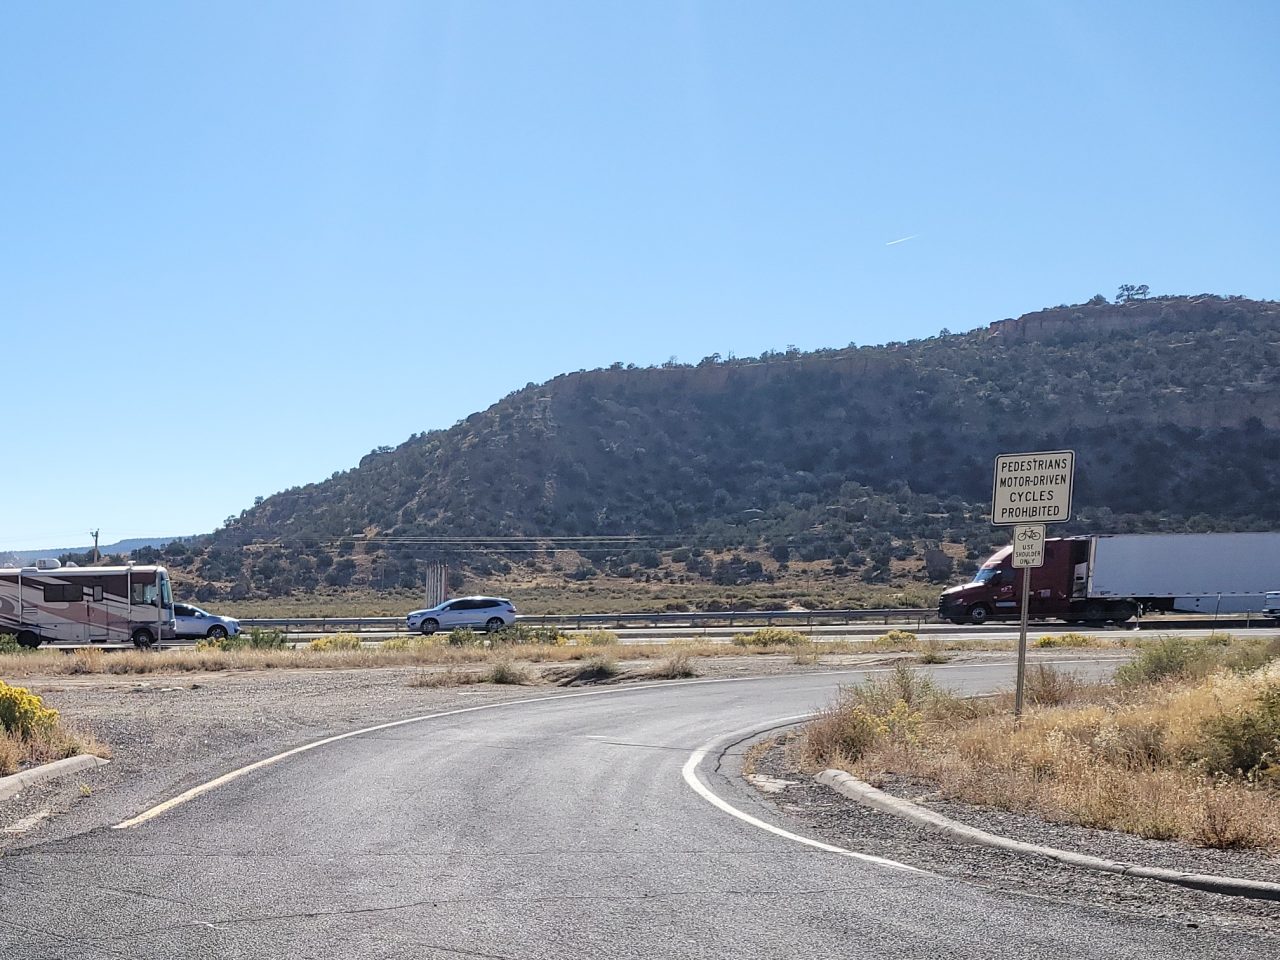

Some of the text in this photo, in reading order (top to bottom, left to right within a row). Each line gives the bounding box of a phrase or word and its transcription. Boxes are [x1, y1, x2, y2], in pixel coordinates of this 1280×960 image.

[1001, 459, 1067, 472] PEDESTRIANS
[1000, 474, 1067, 487] MOTOR-DRIVEN
[1009, 491, 1054, 502] CYCLES
[1001, 506, 1059, 518] PROHIBITED
